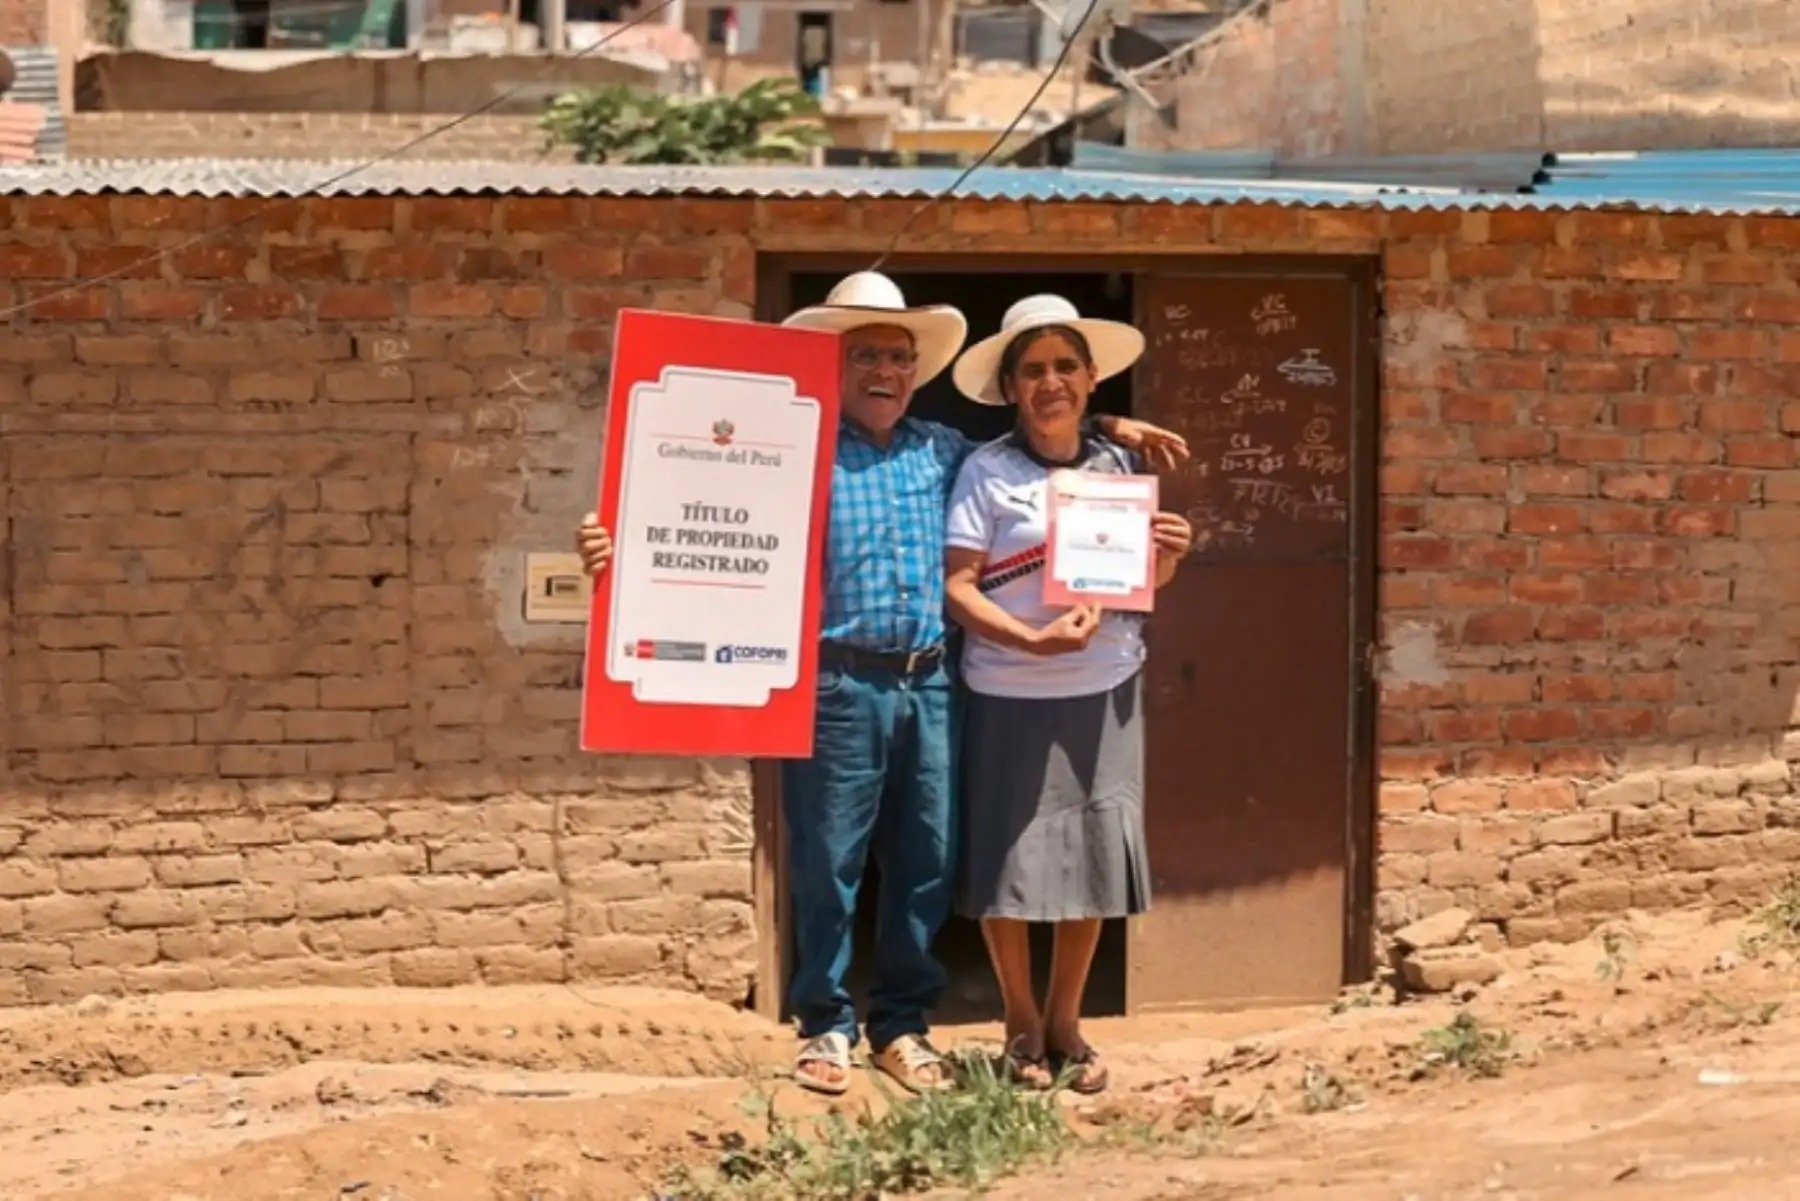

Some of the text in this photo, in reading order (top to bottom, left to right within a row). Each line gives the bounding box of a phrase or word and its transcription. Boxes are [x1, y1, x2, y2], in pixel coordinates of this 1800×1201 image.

[657, 442, 782, 468] Gobierno del Perú
[681, 501, 749, 525] TÍTULO
[646, 526, 779, 551] DE PROPIEDAD
[651, 551, 770, 575] REGISTRADO
[733, 645, 788, 661] COFOPRI
